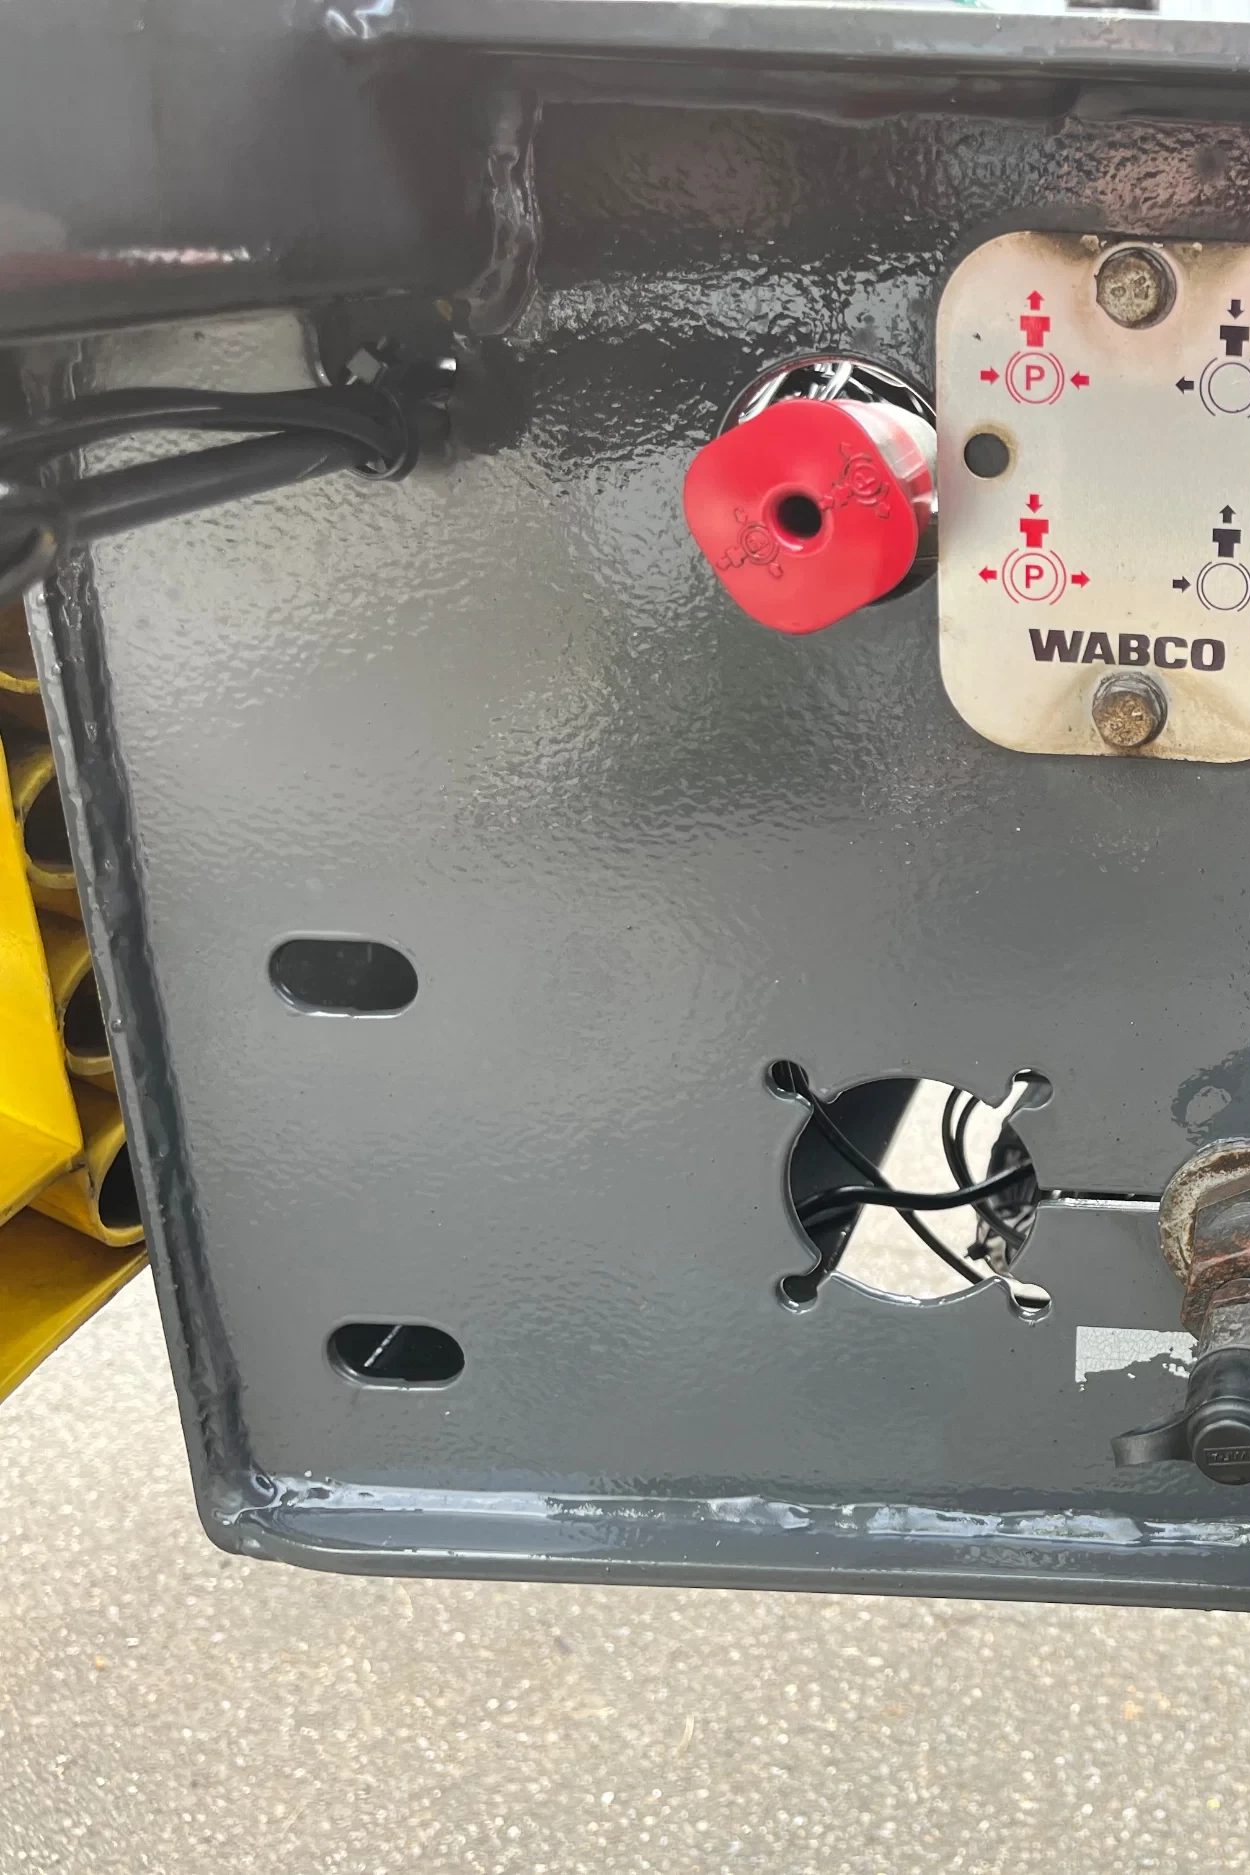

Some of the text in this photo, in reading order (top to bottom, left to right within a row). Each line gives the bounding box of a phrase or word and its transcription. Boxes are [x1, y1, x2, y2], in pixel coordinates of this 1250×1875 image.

[1026, 365, 1045, 391] P
[1026, 565, 1044, 589] P
[1029, 628, 1226, 672] WABCO
